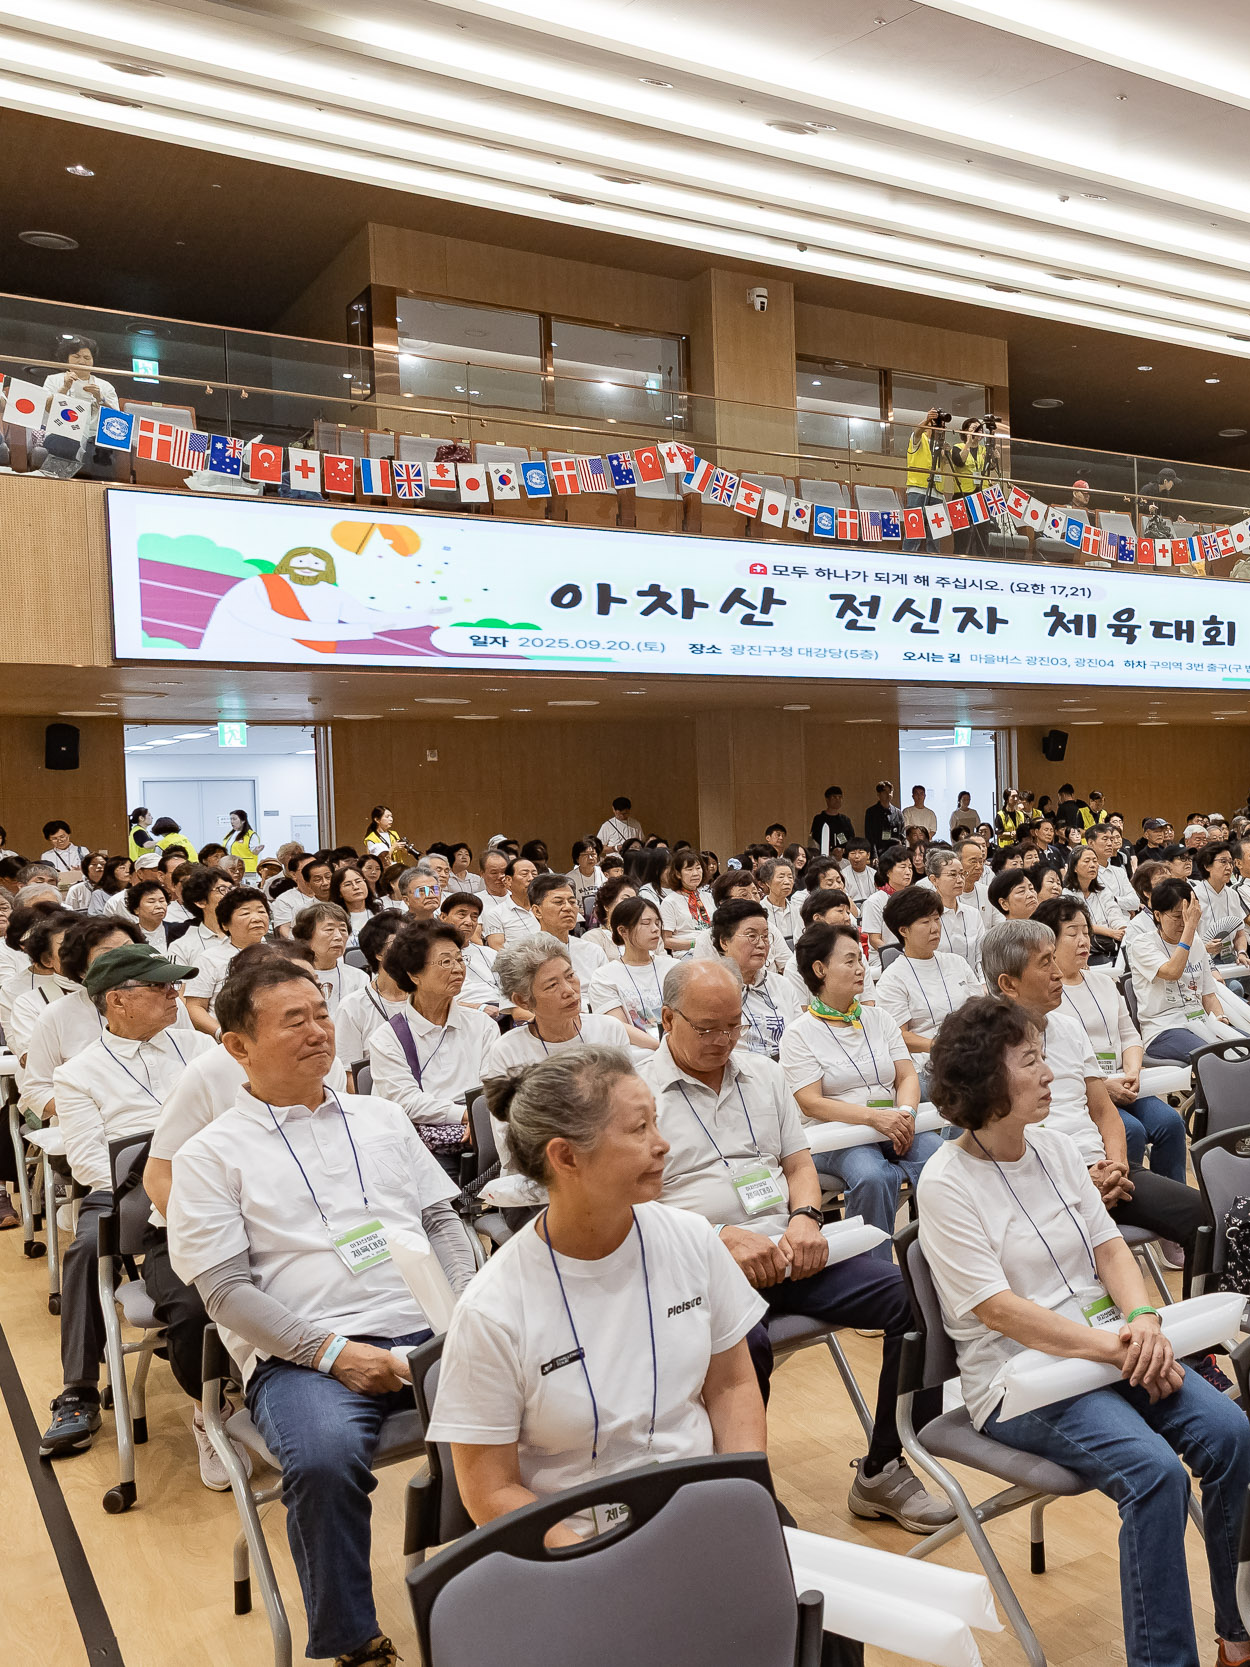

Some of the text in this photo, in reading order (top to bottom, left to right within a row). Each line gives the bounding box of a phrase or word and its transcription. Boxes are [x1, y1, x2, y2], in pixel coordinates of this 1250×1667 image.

[772, 564, 1092, 598] 모두 하나가 되게 해 주십시오. (요한 17,21)
[550, 582, 1236, 646] 아차산 전신자 체육대회
[469, 634, 509, 648] 일자
[518, 637, 666, 653] 2025.09.20.(토)
[688, 643, 722, 655] 장소
[729, 644, 793, 658] 광진구청
[797, 647, 879, 660] 대강당(5층)
[902, 651, 945, 663] 오시는
[947, 652, 961, 664] 길
[970, 653, 1022, 665] 마을버스
[1025, 655, 1071, 668] 광진03,
[1074, 657, 1115, 669] 광진04
[1124, 659, 1147, 670] 하차
[1150, 660, 1183, 671] 구의역
[1185, 661, 1204, 672] 3번
[1206, 663, 1242, 673] 출구(구
[350, 1238, 388, 1258] 체육대회
